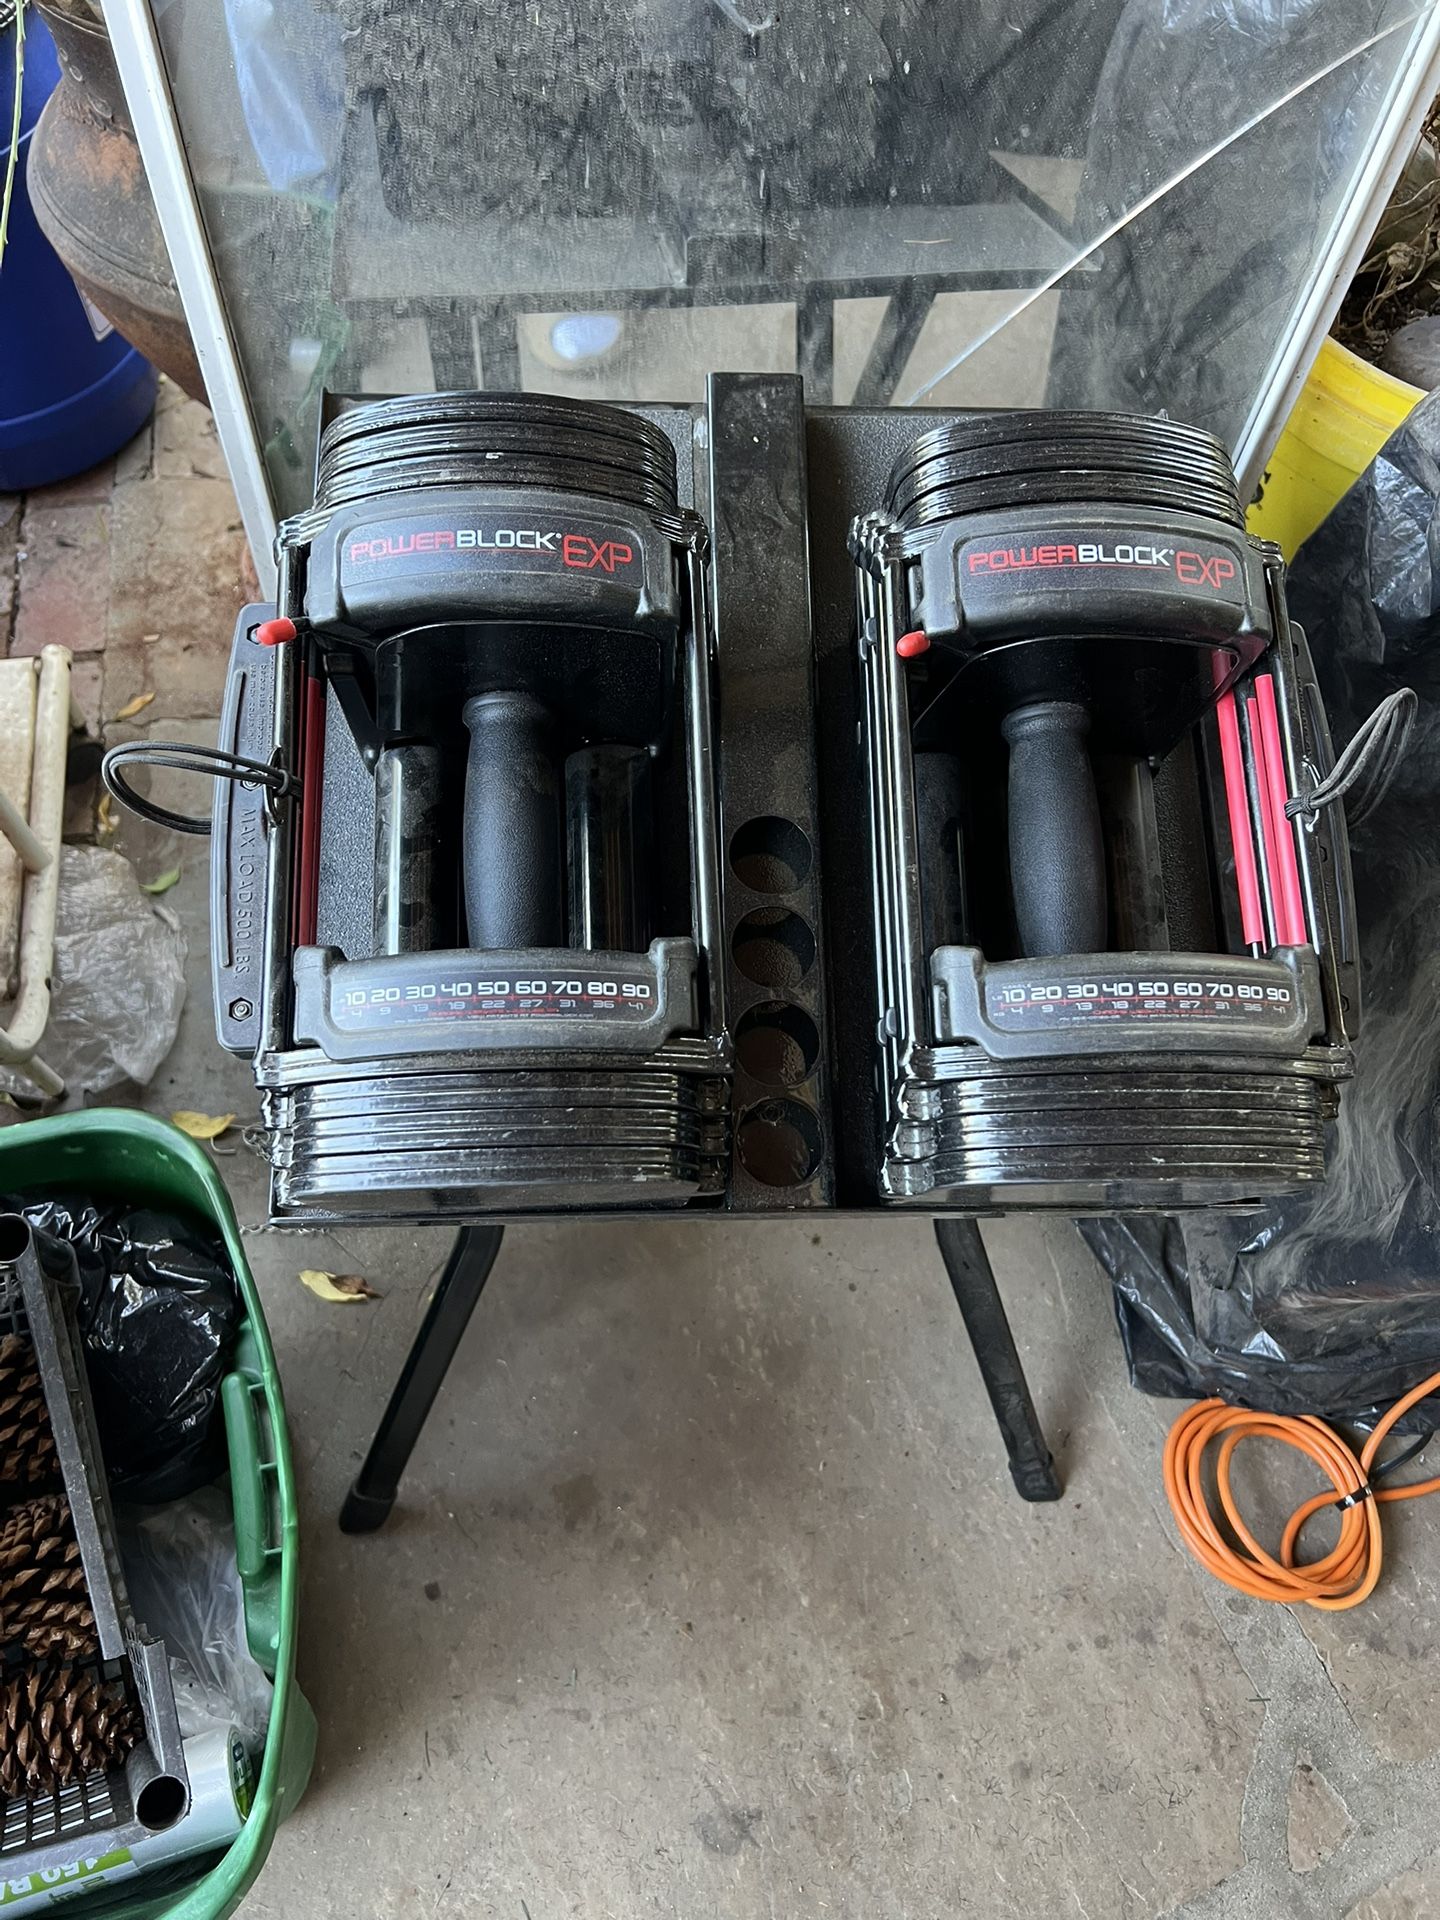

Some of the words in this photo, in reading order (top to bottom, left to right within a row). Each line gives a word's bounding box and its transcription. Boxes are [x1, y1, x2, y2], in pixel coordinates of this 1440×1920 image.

[563, 534, 633, 572] EXP
[1175, 551, 1235, 588] EXP
[240, 808, 256, 848] MAX
[238, 854, 255, 904] LOAD
[236, 909, 252, 940] 500
[235, 946, 251, 979] LBS.
[345, 991, 366, 1006] 10
[371, 987, 400, 1002] 20
[406, 984, 436, 998] 30
[441, 982, 472, 997] 40
[478, 981, 509, 996] 50
[515, 980, 547, 995] 60
[551, 981, 582, 995] 70
[587, 982, 617, 996] 80
[622, 983, 650, 998] 90
[351, 1008, 362, 1017] 4
[379, 1006, 391, 1015] 9
[412, 1004, 429, 1012] 13
[447, 1001, 466, 1009] 18
[482, 1000, 505, 1009] 22
[519, 999, 544, 1008] 27
[559, 1000, 576, 1008] 31
[628, 1003, 644, 1011] 41
[1003, 988, 1025, 1003] 10
[1030, 986, 1062, 1000] 20
[1067, 984, 1098, 998] 30
[1102, 982, 1133, 997] 40
[1138, 982, 1168, 996] 50
[1174, 982, 1203, 996] 60
[1206, 983, 1234, 997] 70
[1237, 985, 1262, 999] 80
[1266, 987, 1290, 1001] 90
[1011, 1007, 1023, 1015] 4
[1041, 1004, 1054, 1013] 9
[1076, 1002, 1092, 1010] 13
[1112, 1001, 1129, 1009] 18
[1144, 1000, 1166, 1008] 22
[1179, 1000, 1201, 1009] 27
[1215, 1001, 1230, 1009] 31
[1273, 1005, 1287, 1014] 41
